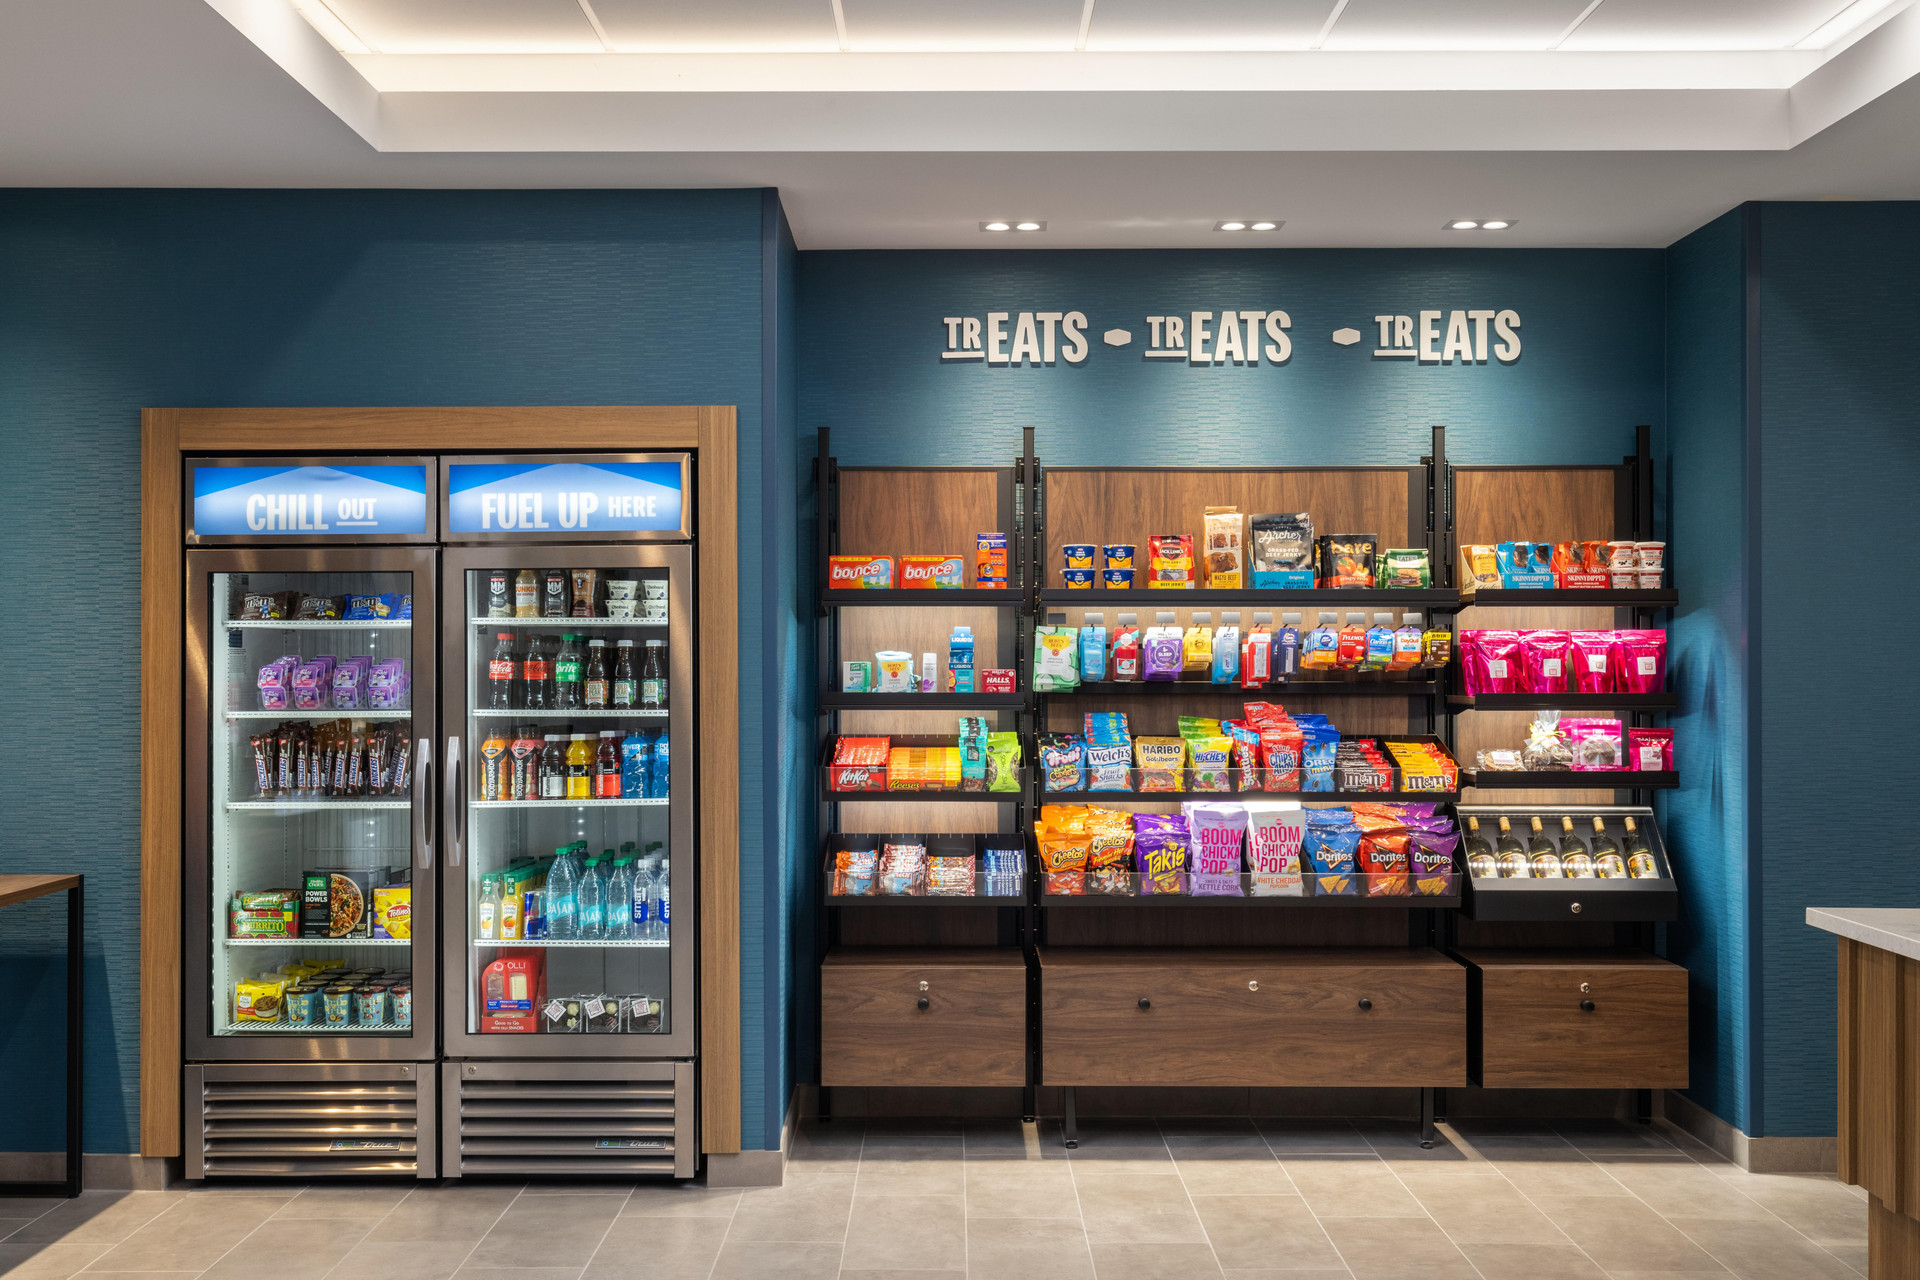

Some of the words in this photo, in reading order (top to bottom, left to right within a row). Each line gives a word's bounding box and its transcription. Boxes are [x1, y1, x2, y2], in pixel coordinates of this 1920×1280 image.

[942, 310, 1089, 364] TREATS
[1145, 309, 1292, 363] TREATS
[1374, 309, 1522, 363] TREATS
[246, 493, 329, 531] CHILL
[337, 498, 377, 522] OUT
[481, 492, 549, 529] FUEL
[558, 491, 599, 528] UP
[608, 495, 657, 518] HERE
[1258, 529, 1303, 545] Archer
[1329, 540, 1372, 555] bare
[832, 564, 880, 580] bounce
[904, 564, 953, 580] bounce
[1045, 746, 1081, 767] Trolli
[1090, 748, 1131, 762] Welch's
[1142, 745, 1181, 754] HARIBO
[1194, 752, 1227, 763] HI-CHEW
[1303, 759, 1335, 768] OREO
[1311, 765, 1332, 774] mini
[279, 758, 288, 787] SNICKERS
[369, 757, 381, 787] SNICKERS
[1344, 773, 1387, 787] m&m's
[1407, 774, 1453, 790] m&m's
[1201, 828, 1242, 845] BOOM
[1259, 826, 1301, 843] BOOM
[1091, 836, 1126, 855] Cheetos
[1202, 846, 1240, 859] CHICKA
[1262, 843, 1300, 857] CHICKA
[1051, 847, 1085, 868] Cheetos
[1144, 841, 1185, 880] Takis
[1316, 850, 1353, 861] Doritos
[1370, 852, 1406, 863] Doritos
[1414, 852, 1452, 864] Doritos
[1201, 859, 1228, 875] POP
[1260, 856, 1288, 873] POP
[633, 886, 642, 919] smart
[242, 921, 284, 932] BURRITO
[507, 961, 526, 970] OLLI
